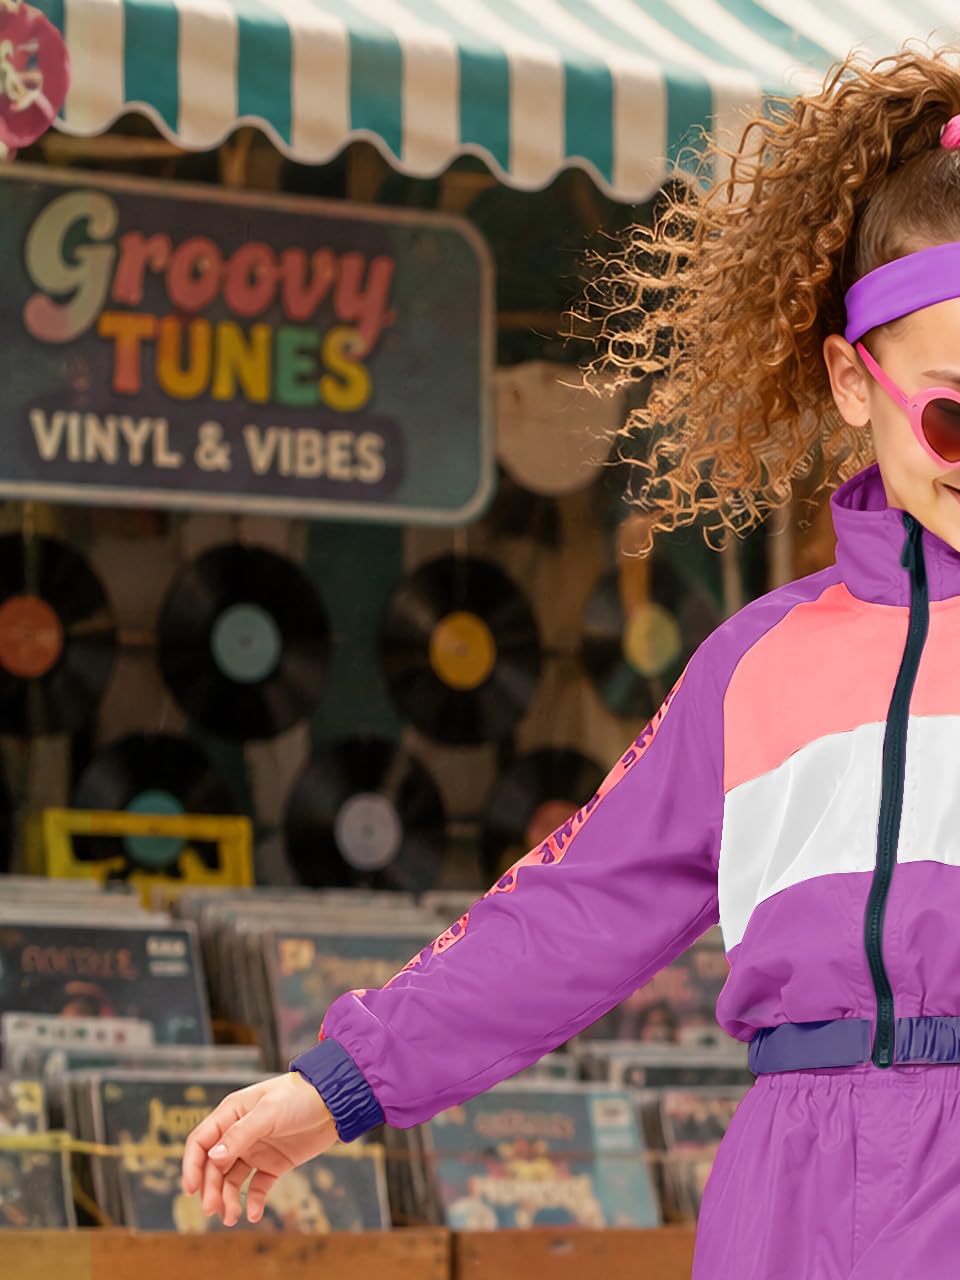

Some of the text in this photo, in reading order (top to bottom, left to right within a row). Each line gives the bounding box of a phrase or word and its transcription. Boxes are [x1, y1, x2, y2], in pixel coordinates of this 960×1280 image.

[24, 190, 396, 358] Groovy
[98, 310, 372, 412] TUNES
[29, 408, 387, 484] VINYL & VIBES
